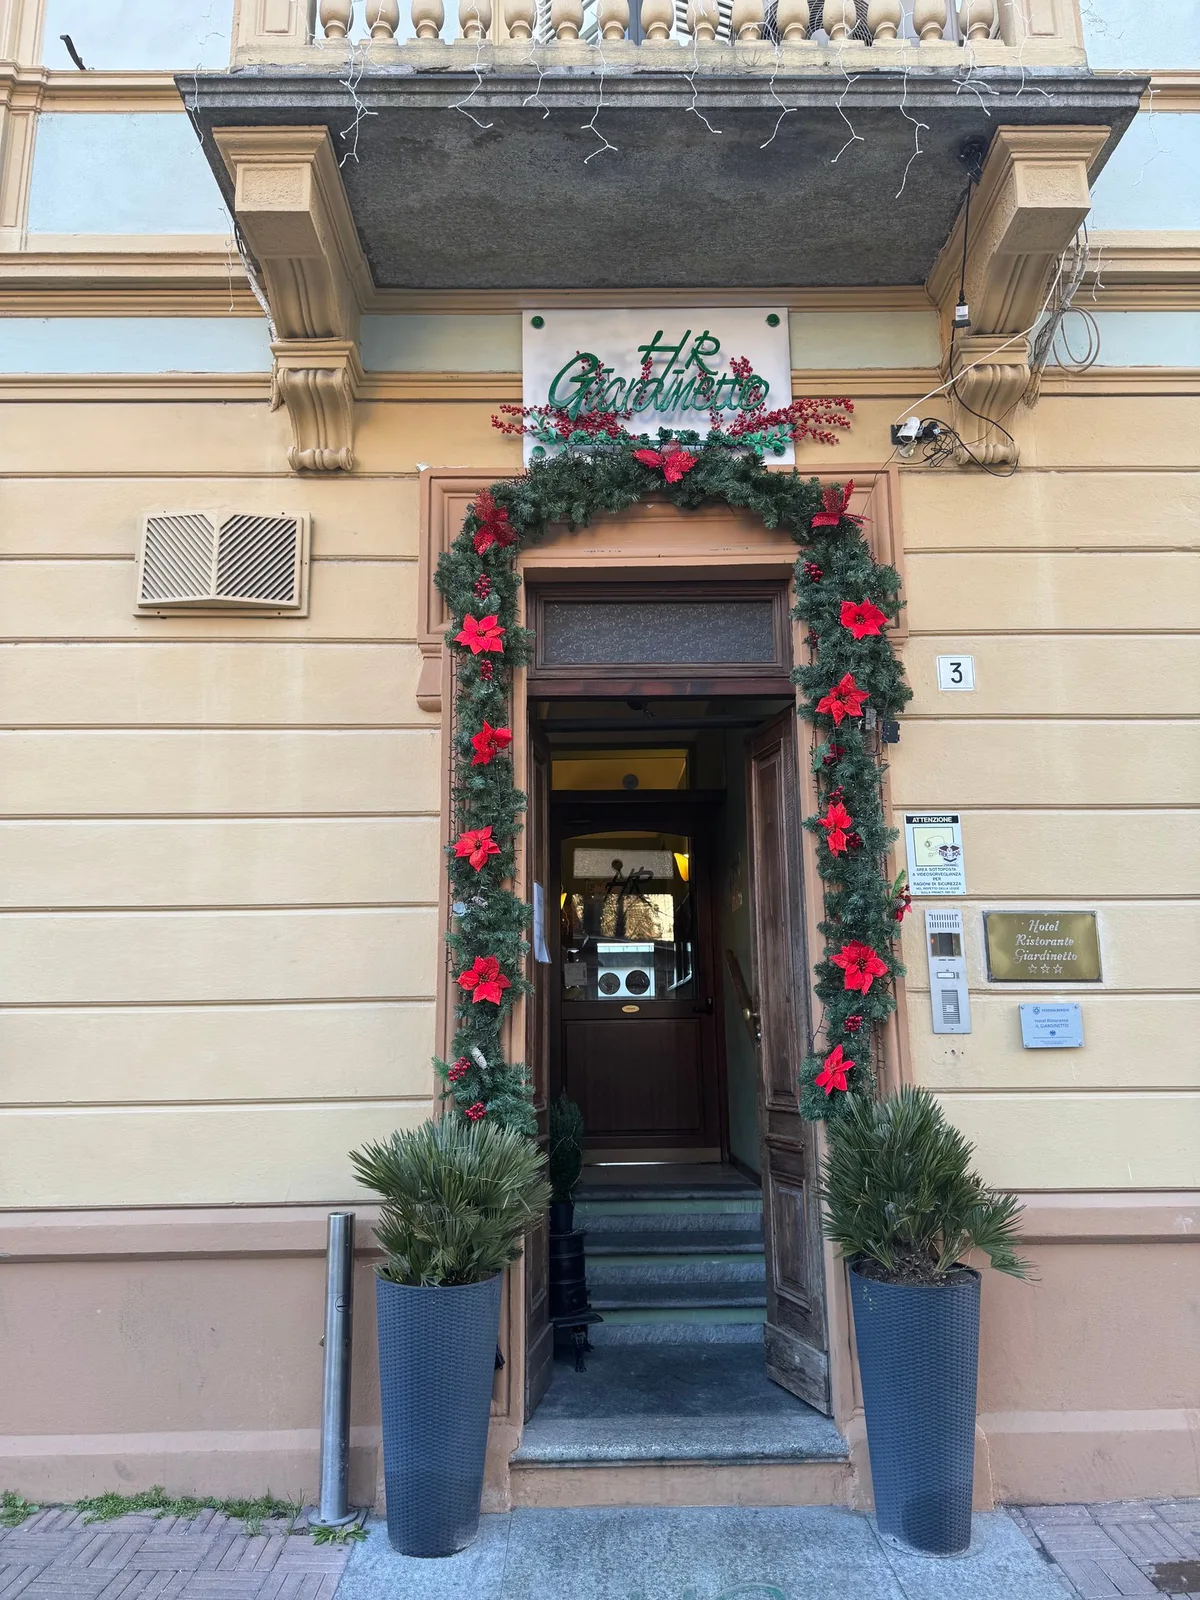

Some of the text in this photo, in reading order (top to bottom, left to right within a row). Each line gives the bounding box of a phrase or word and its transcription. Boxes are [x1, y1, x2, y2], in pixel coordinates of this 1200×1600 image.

[638, 329, 721, 382] HR
[548, 352, 770, 421] Giardinetto
[949, 662, 963, 684] 3
[1028, 919, 1060, 933] Hotel
[1014, 934, 1075, 947] Ristorante
[1012, 949, 1078, 963] Giardinetto
